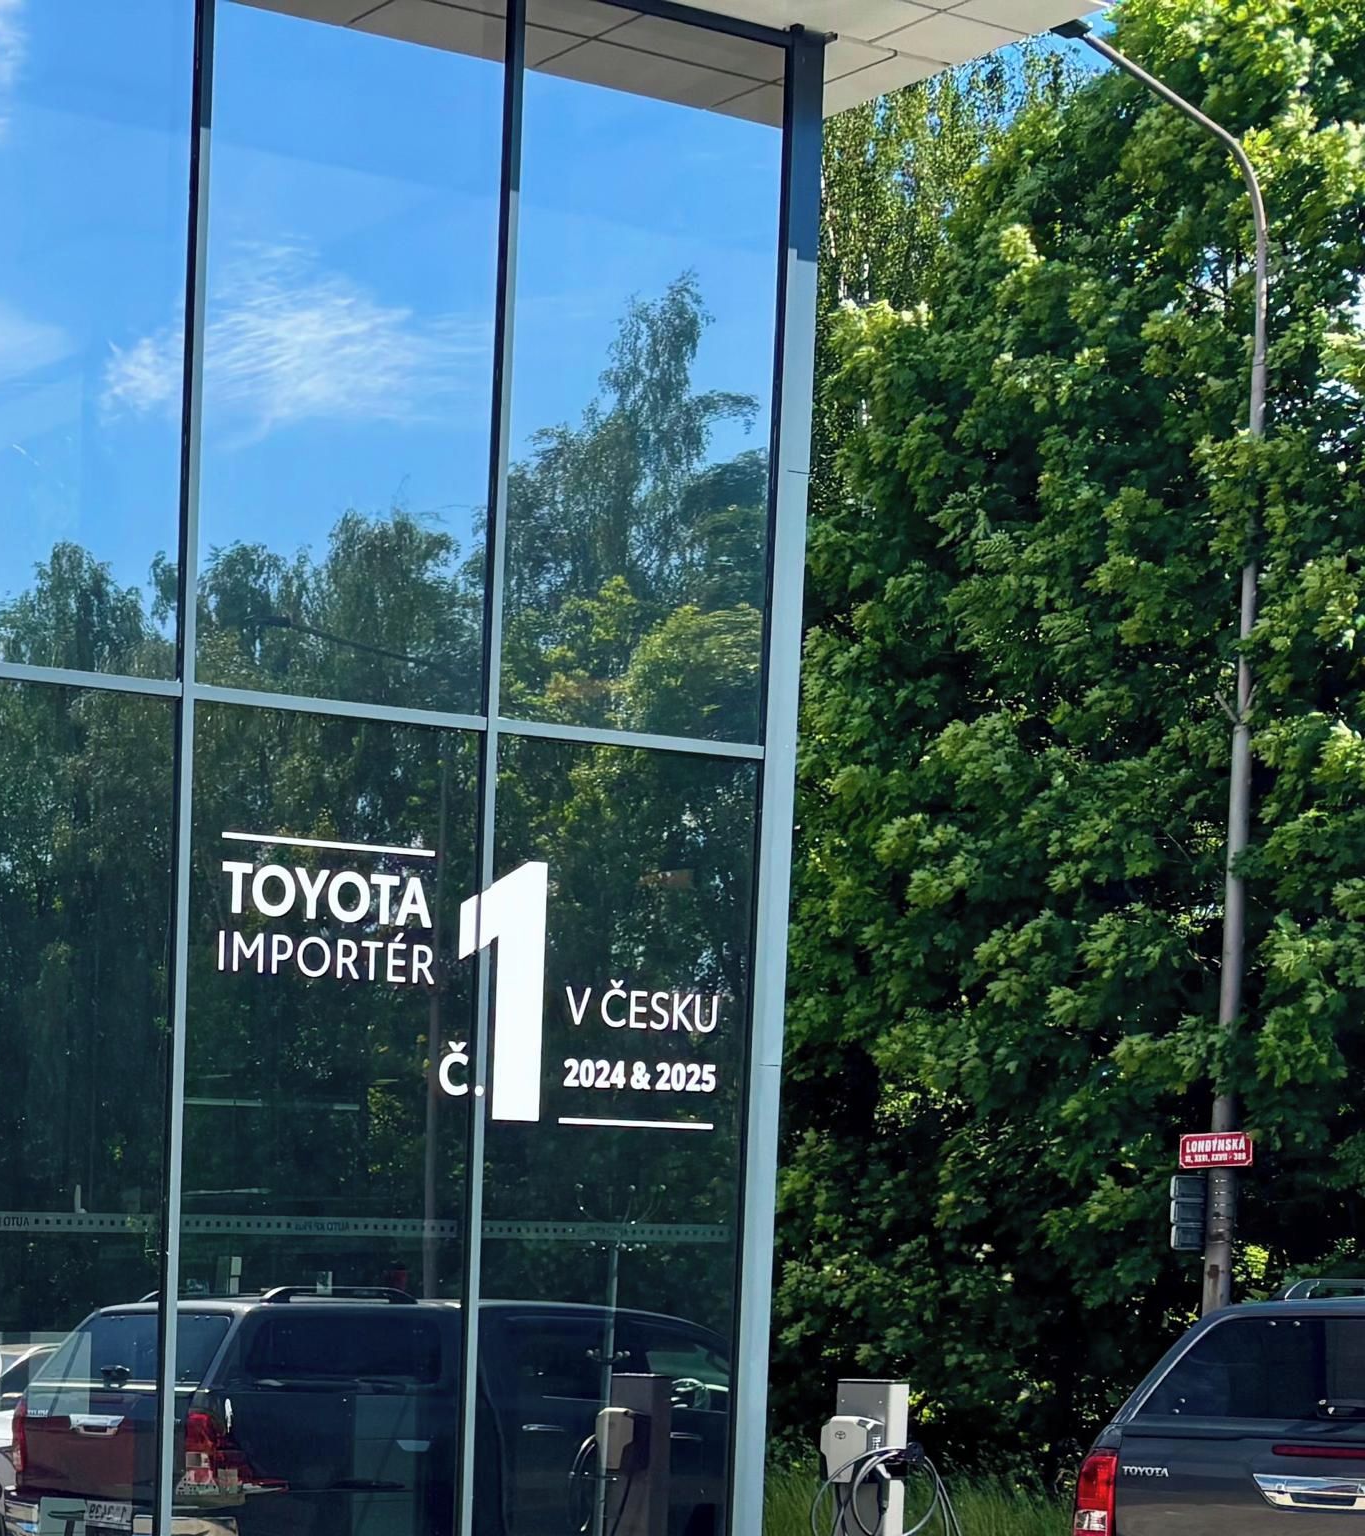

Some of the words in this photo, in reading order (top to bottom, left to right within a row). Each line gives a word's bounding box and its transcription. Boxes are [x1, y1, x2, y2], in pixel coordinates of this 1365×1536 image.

[222, 861, 432, 929] TOYOTA
[217, 930, 435, 986] IMPORTÉR
[458, 861, 548, 1122] 1
[565, 985, 592, 1026] V
[600, 979, 719, 1033] ČESKU
[438, 1041, 485, 1097] Č.
[563, 1058, 626, 1089] 2024
[630, 1061, 651, 1090] &
[655, 1062, 717, 1093] 2025
[1186, 1135, 1246, 1153] LONDÝNSKÁ
[1122, 1466, 1169, 1478] TOYOTA
